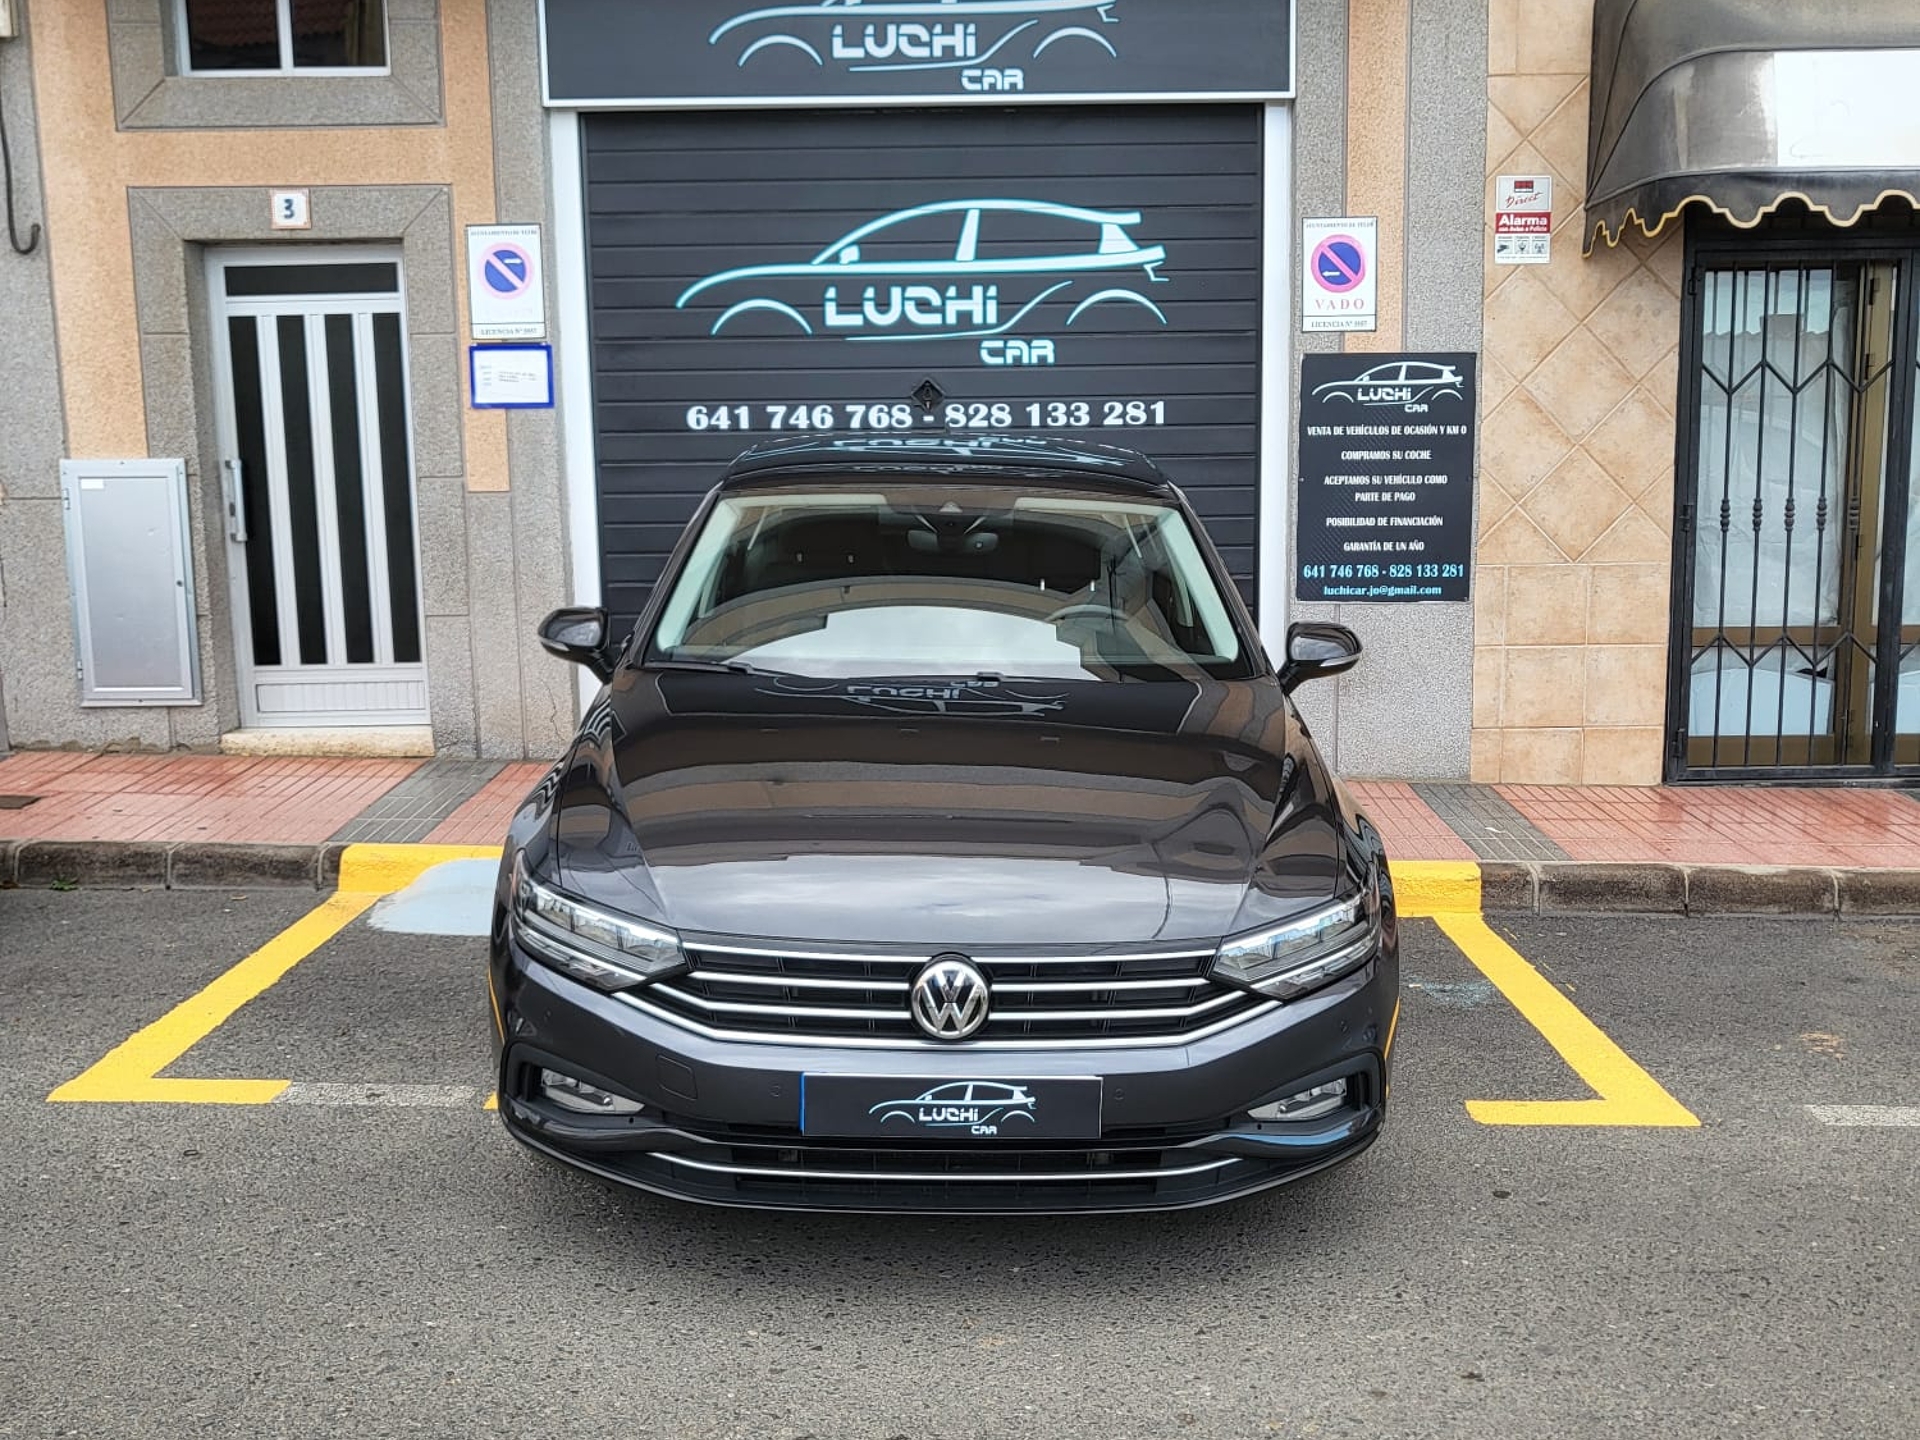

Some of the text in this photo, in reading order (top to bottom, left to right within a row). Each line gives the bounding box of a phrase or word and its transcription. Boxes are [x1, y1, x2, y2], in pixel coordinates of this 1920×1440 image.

[961, 68, 1024, 90] CAR
[284, 198, 295, 219] 3
[1499, 214, 1547, 226] Alarma
[1315, 299, 1365, 310] VADO
[1311, 320, 1344, 328] LICENCIA
[979, 339, 1056, 365] CAR
[1404, 403, 1429, 413] CAR
[686, 404, 750, 430] 641
[766, 404, 834, 429] 746
[845, 404, 913, 429] 768
[945, 403, 1012, 428] 828
[1025, 402, 1090, 427] 133
[1103, 400, 1165, 425] 281
[1307, 425, 1332, 436] VENTA
[1333, 425, 1344, 435] DE
[1346, 423, 1390, 436] VEHÍCULOS
[1391, 425, 1402, 435] DE
[1403, 423, 1438, 435] OCASIÓN
[1439, 425, 1445, 434] Y
[1341, 450, 1432, 460] COMPRAMOS SU COCHE
[1324, 472, 1448, 485] ACEPTAMOS SU VEHÍCULO COMO
[1355, 491, 1416, 501] PARTE DE PAGO
[1326, 515, 1443, 527] POSIBILIDAD DE FINANCIACIÓN
[1343, 539, 1425, 551] GARANTÍA DE UN AÑO
[1303, 564, 1325, 578] 641
[1330, 564, 1353, 578] 746
[1356, 564, 1379, 578] 768
[1389, 564, 1412, 578] 828
[1416, 564, 1439, 578] 133
[1442, 563, 1464, 577] 281
[1323, 585, 1442, 597] luchicar.jo@gmail.com
[971, 1125, 997, 1135] CAR
